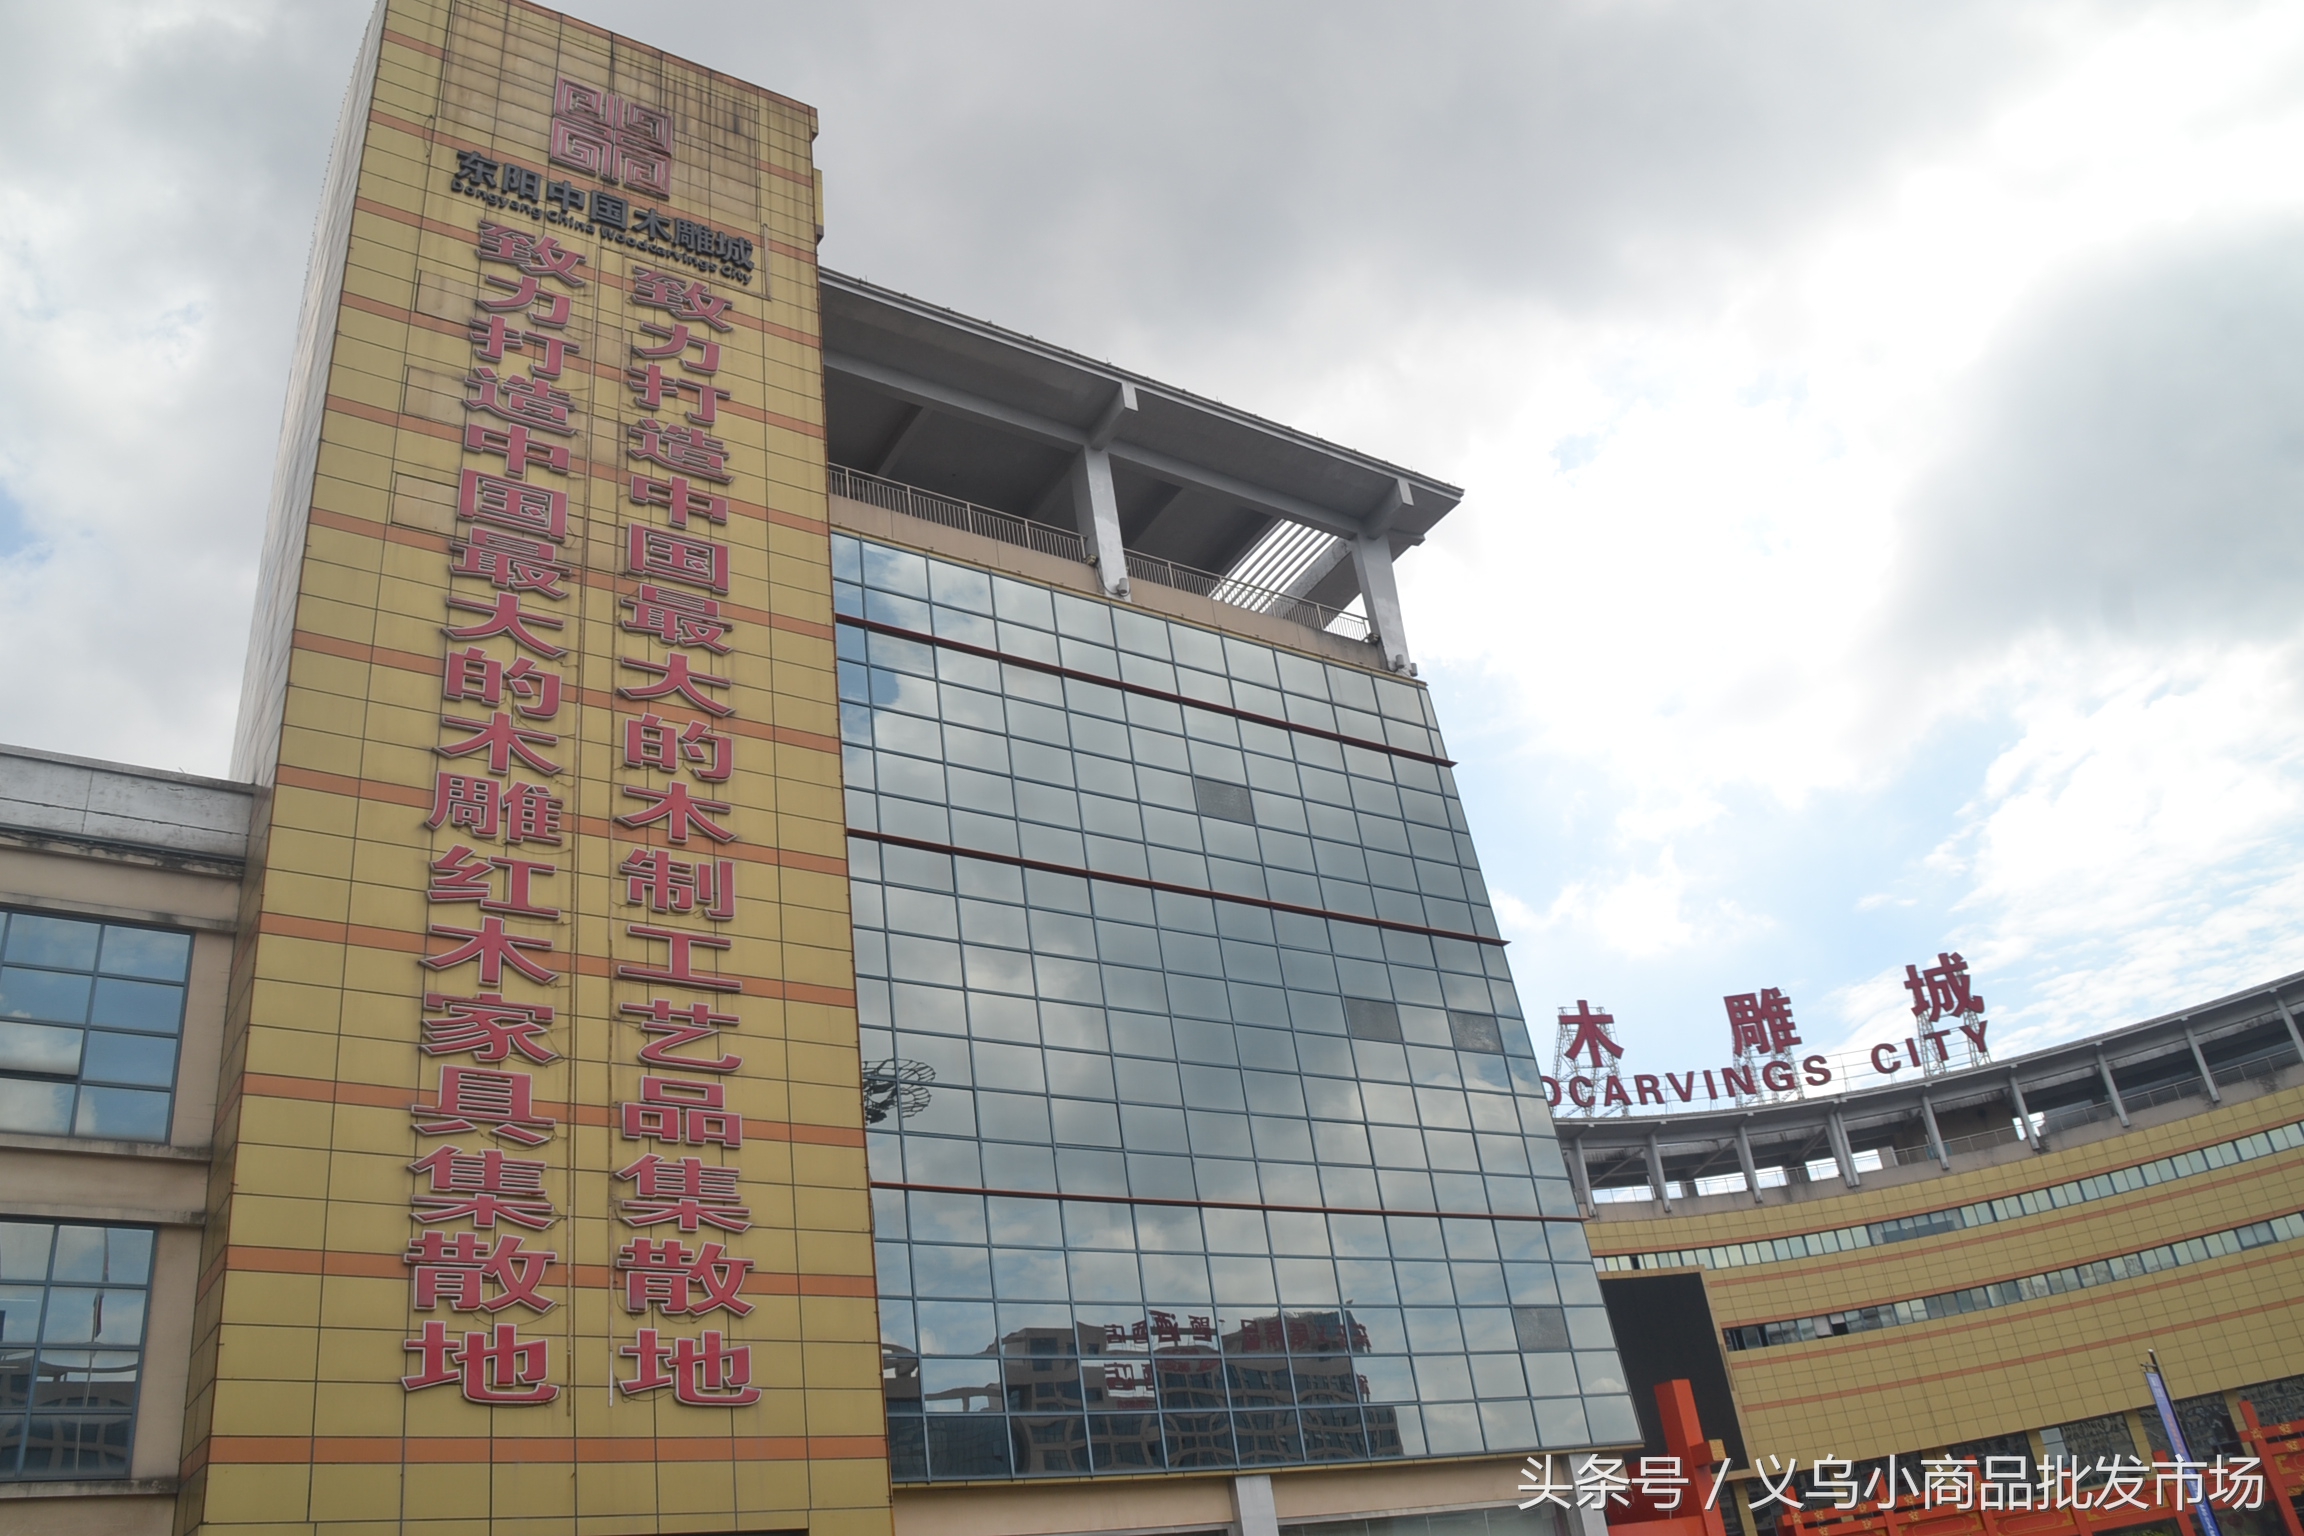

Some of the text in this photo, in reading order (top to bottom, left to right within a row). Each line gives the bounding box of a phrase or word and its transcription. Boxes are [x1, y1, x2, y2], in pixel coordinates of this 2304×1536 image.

[451, 178, 543, 220] Dongyang
[546, 209, 596, 235] China
[720, 264, 753, 285] City
[455, 151, 754, 271] 东阳中国木雕城
[401, 219, 587, 1404] 致力打造中国最大的木雕红木家具集散地
[614, 265, 762, 1406] 致力打造中国最大的木制工艺品集散地
[1558, 951, 1985, 1068] 木雕城
[1870, 1020, 1989, 1074] CITY
